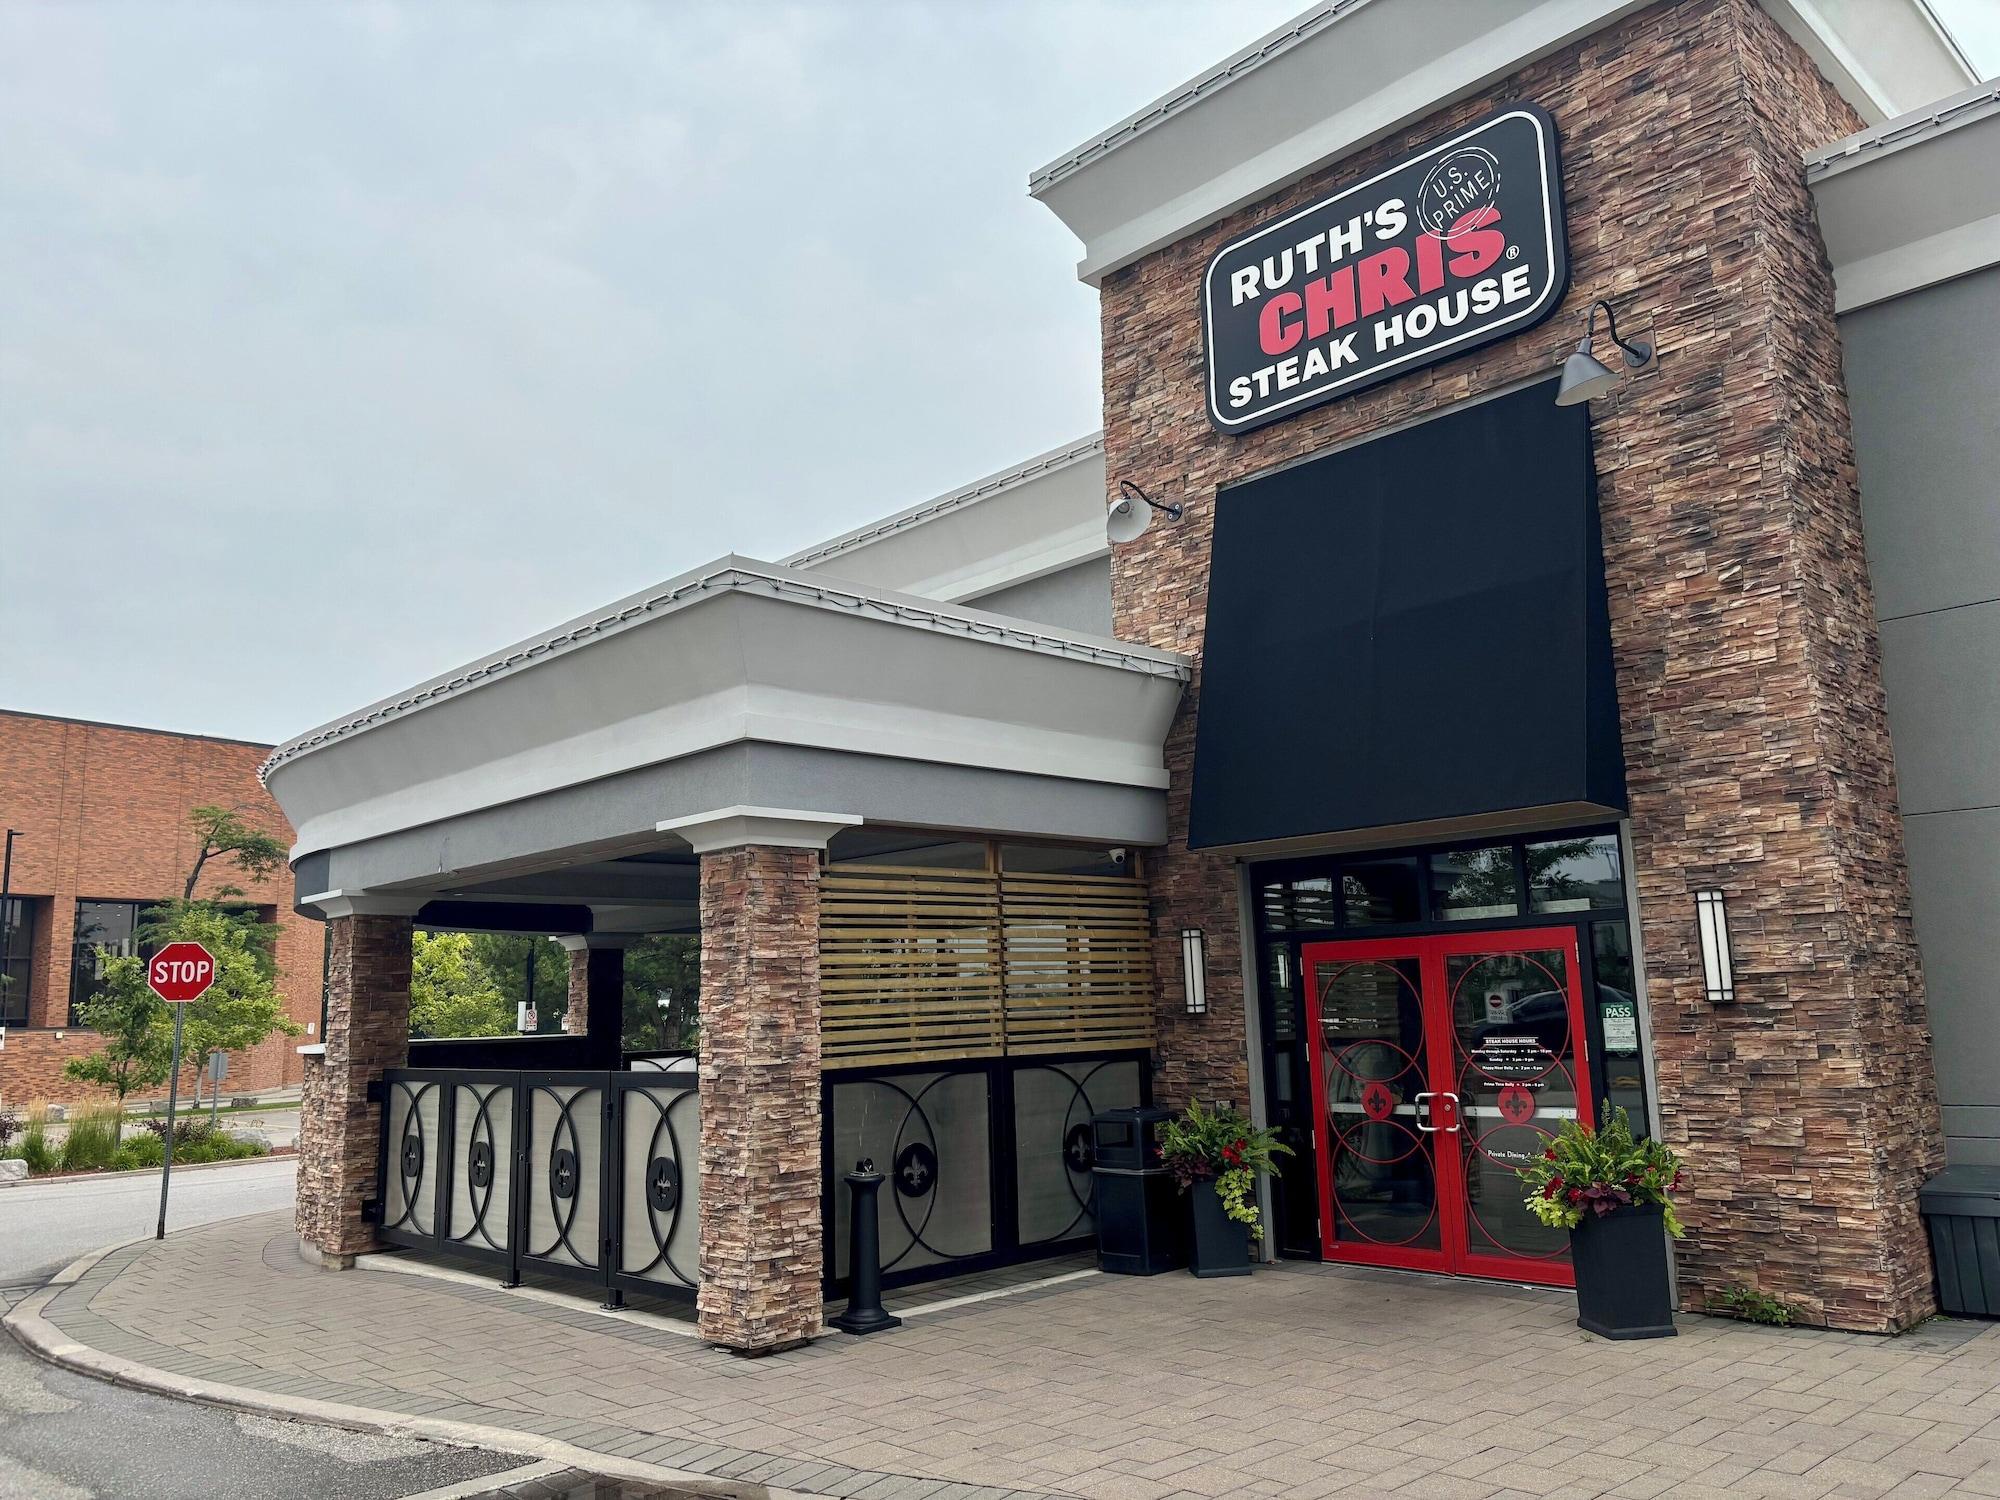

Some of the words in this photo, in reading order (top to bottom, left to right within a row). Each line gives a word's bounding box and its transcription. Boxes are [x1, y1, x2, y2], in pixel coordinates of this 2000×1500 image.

[1432, 165, 1469, 200] U.S.
[1432, 169, 1493, 230] PRIME
[1230, 198, 1408, 307] RUTH'S
[1258, 207, 1506, 356] CHRIS
[1228, 331, 1360, 408] STEAK
[1374, 263, 1532, 353] HOUSE
[154, 960, 210, 984] STOP
[1605, 1007, 1631, 1018] PASS
[1487, 1149, 1506, 1158] Private
[1507, 1150, 1526, 1160] Dining
